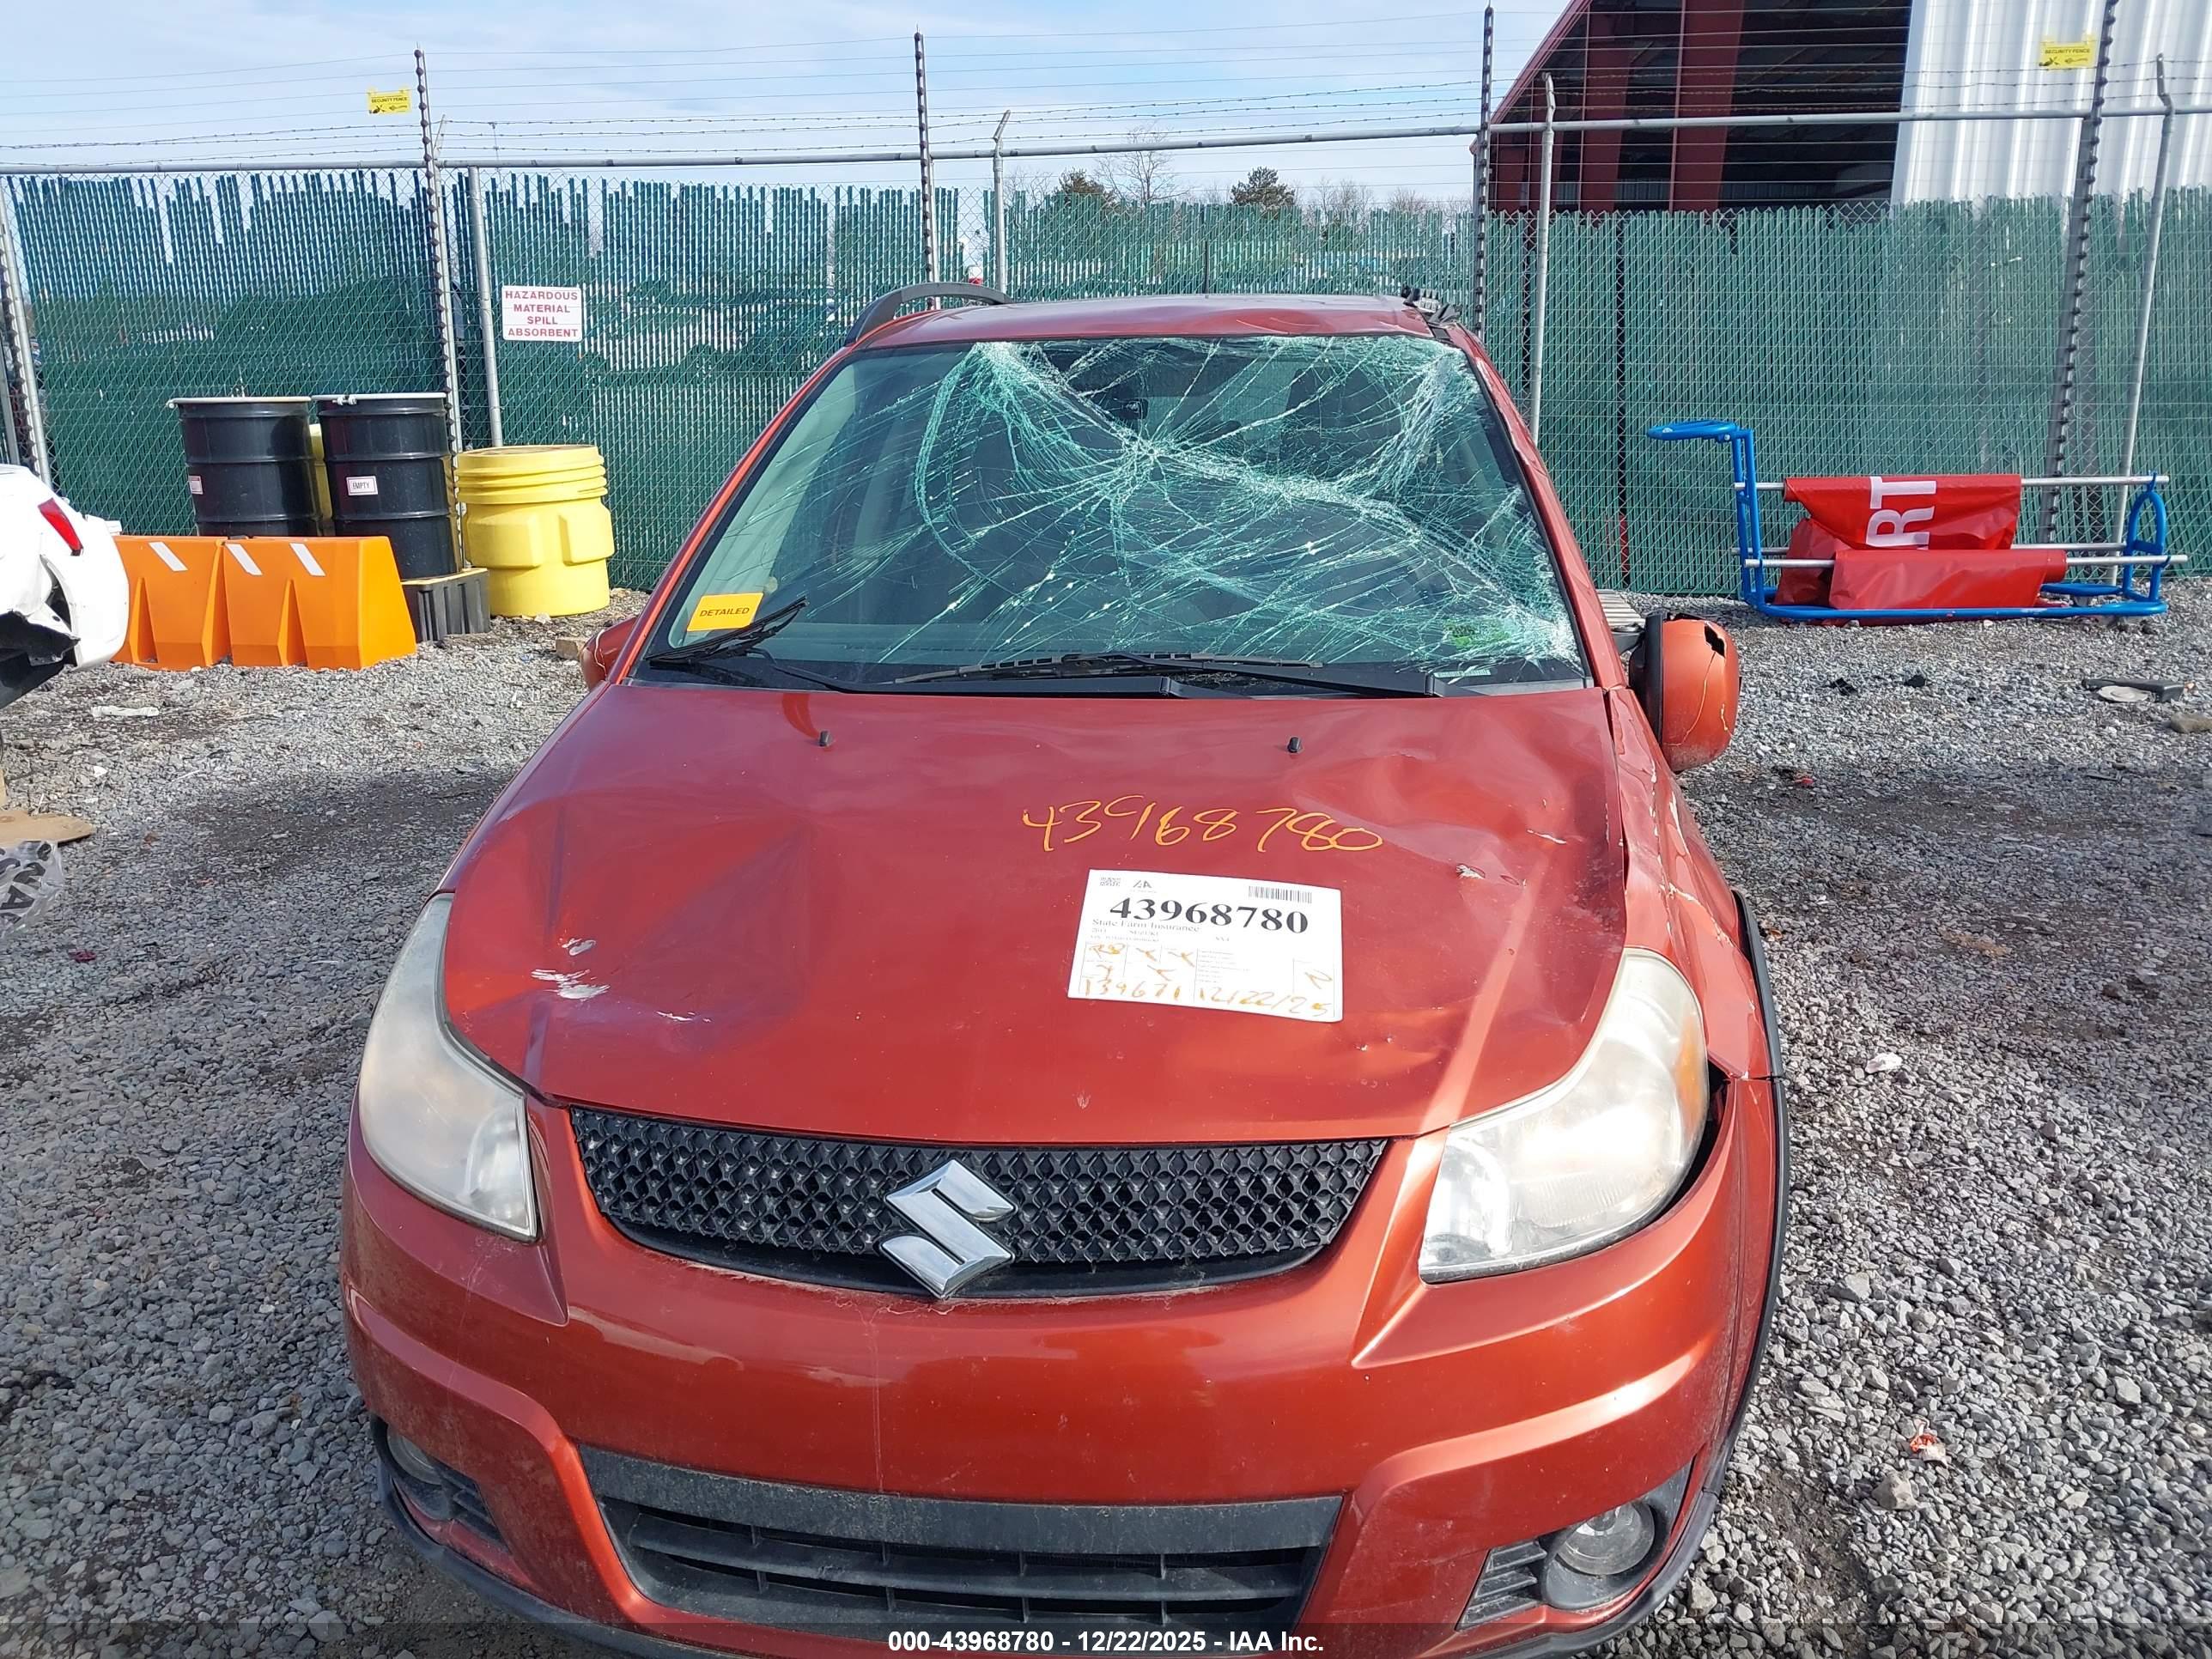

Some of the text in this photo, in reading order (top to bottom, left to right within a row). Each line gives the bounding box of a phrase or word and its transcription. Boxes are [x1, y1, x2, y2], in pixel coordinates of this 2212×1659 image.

[505, 290, 578, 301] HAZARDOUS
[514, 304, 570, 313] MATERIAL
[527, 316, 558, 325] SPILL
[507, 328, 579, 337] ABSORBENT
[1865, 476, 1937, 550] RT
[699, 607, 750, 617] DETAILED
[1109, 897, 1309, 933] 43968780
[1121, 920, 1147, 928] Farm
[1151, 921, 1200, 933] Insurance
